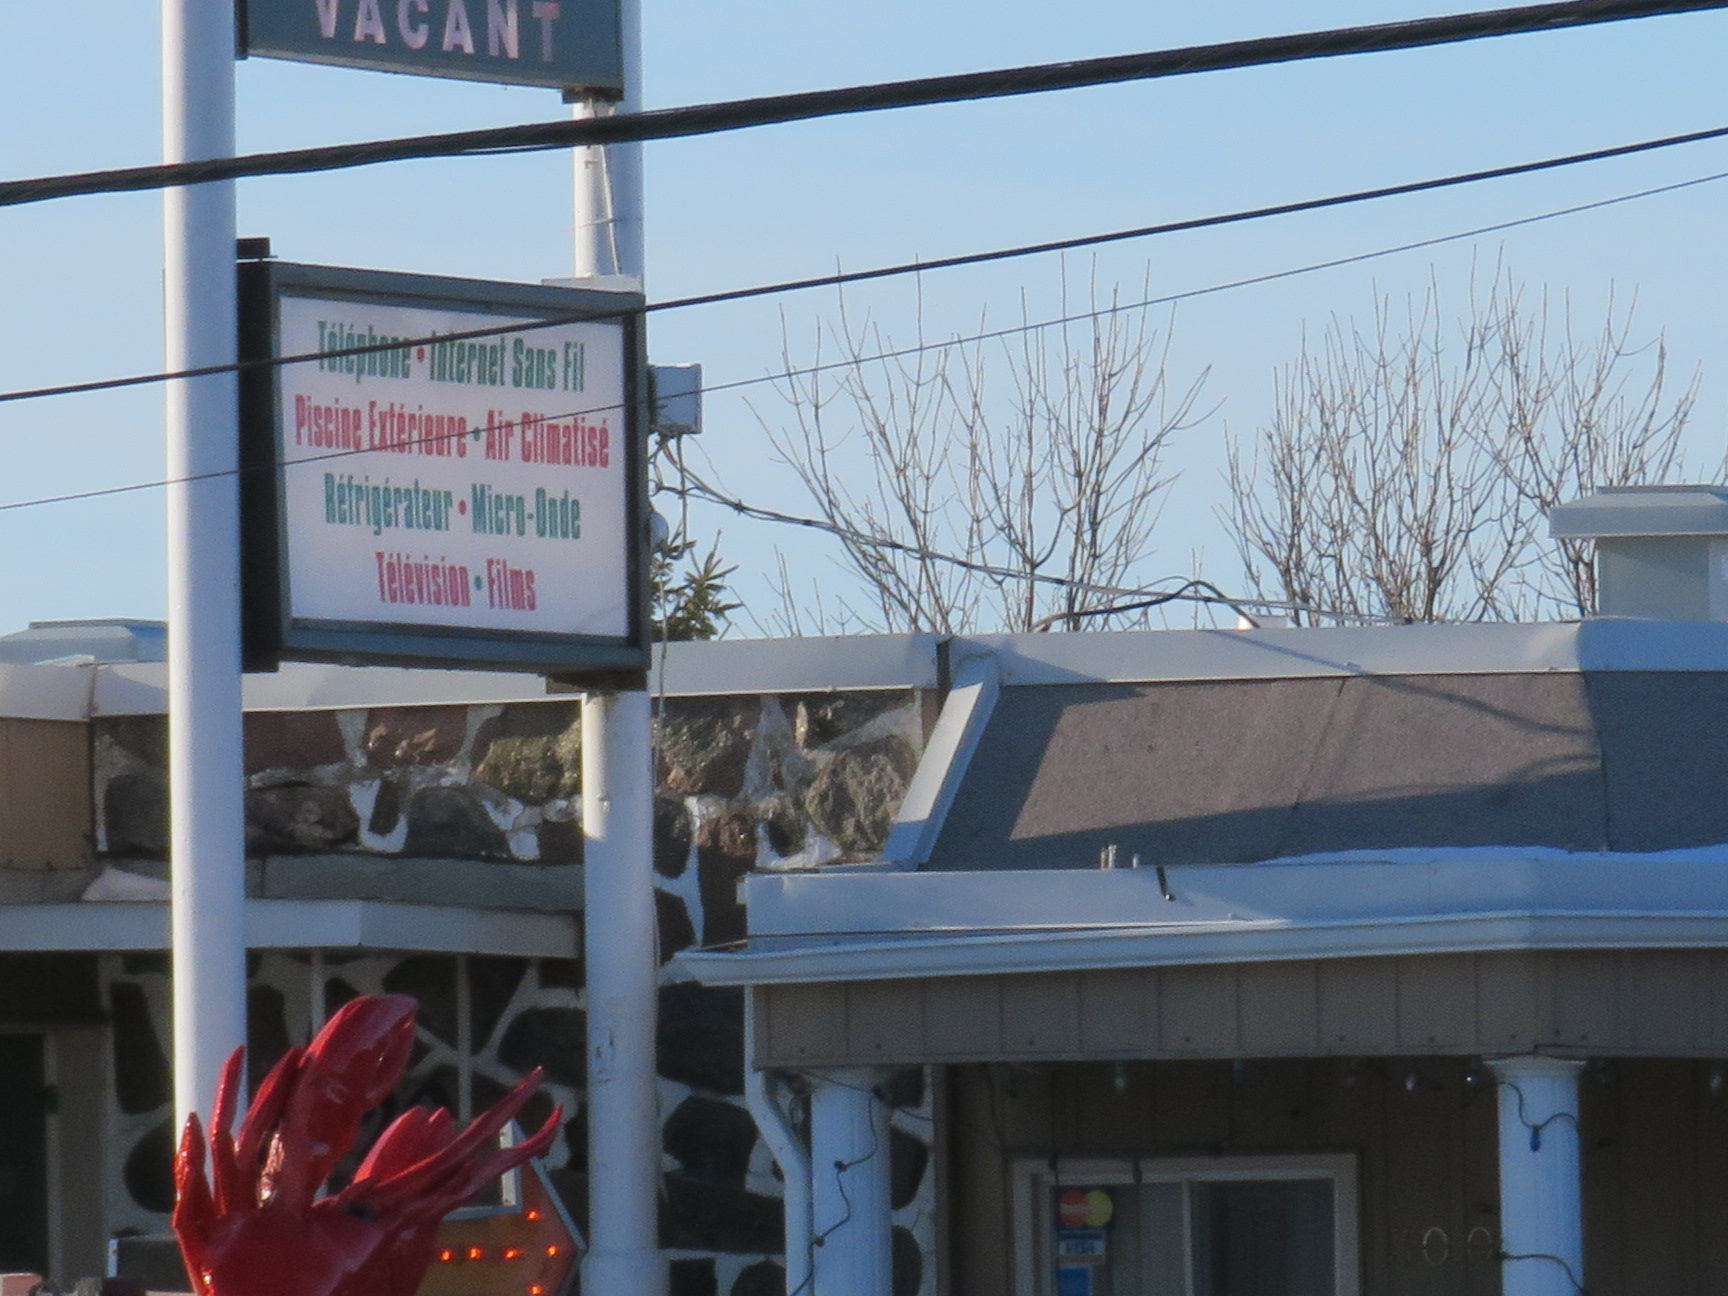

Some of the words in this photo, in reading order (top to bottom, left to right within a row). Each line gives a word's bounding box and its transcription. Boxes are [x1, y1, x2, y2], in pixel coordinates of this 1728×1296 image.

[316, 320, 411, 385] Téléphone
[429, 329, 506, 387] Internet
[512, 337, 557, 391] Sans
[563, 340, 586, 393] Fil
[295, 393, 362, 451] Piscine
[368, 400, 468, 459] Extérieure
[485, 409, 514, 461] Air
[521, 411, 610, 468] Climatisé
[323, 472, 453, 536] Réfrigérateur
[471, 482, 581, 540] Micro-Onde
[375, 551, 471, 608] Télévision
[486, 558, 537, 611] Films
